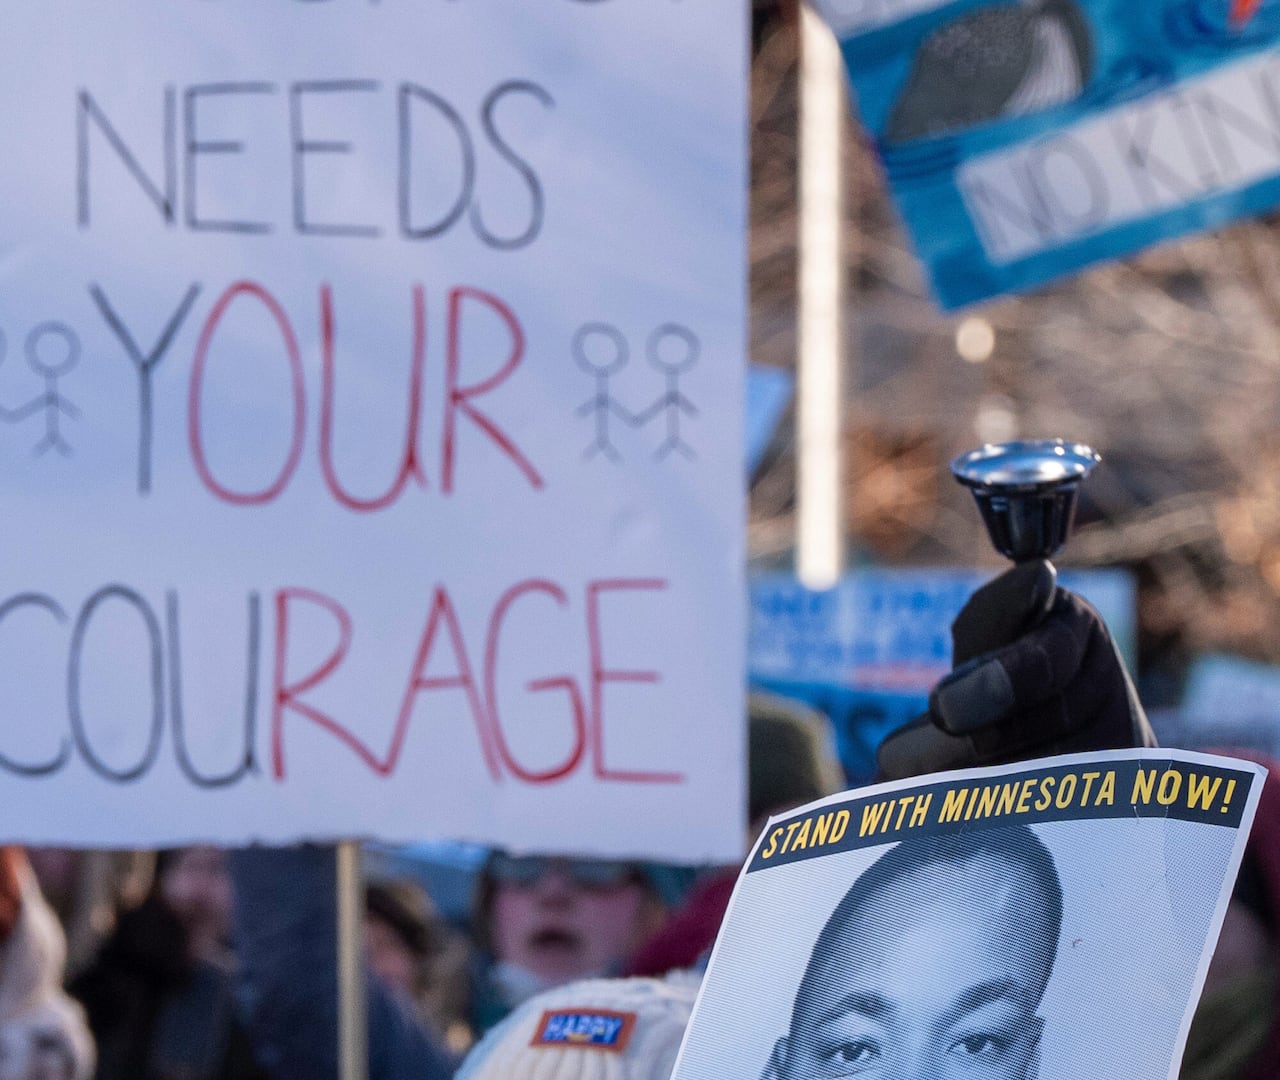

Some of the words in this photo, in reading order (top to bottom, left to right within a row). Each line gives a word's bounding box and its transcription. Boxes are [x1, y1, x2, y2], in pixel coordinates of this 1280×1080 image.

[77, 79, 556, 252] NEEDS
[966, 130, 1111, 256] NO
[89, 280, 545, 513] YOUR
[761, 810, 850, 859] STAND
[860, 792, 932, 837] WITH
[939, 770, 1116, 822] MINNESOTA
[1131, 769, 1237, 814] NOW!
